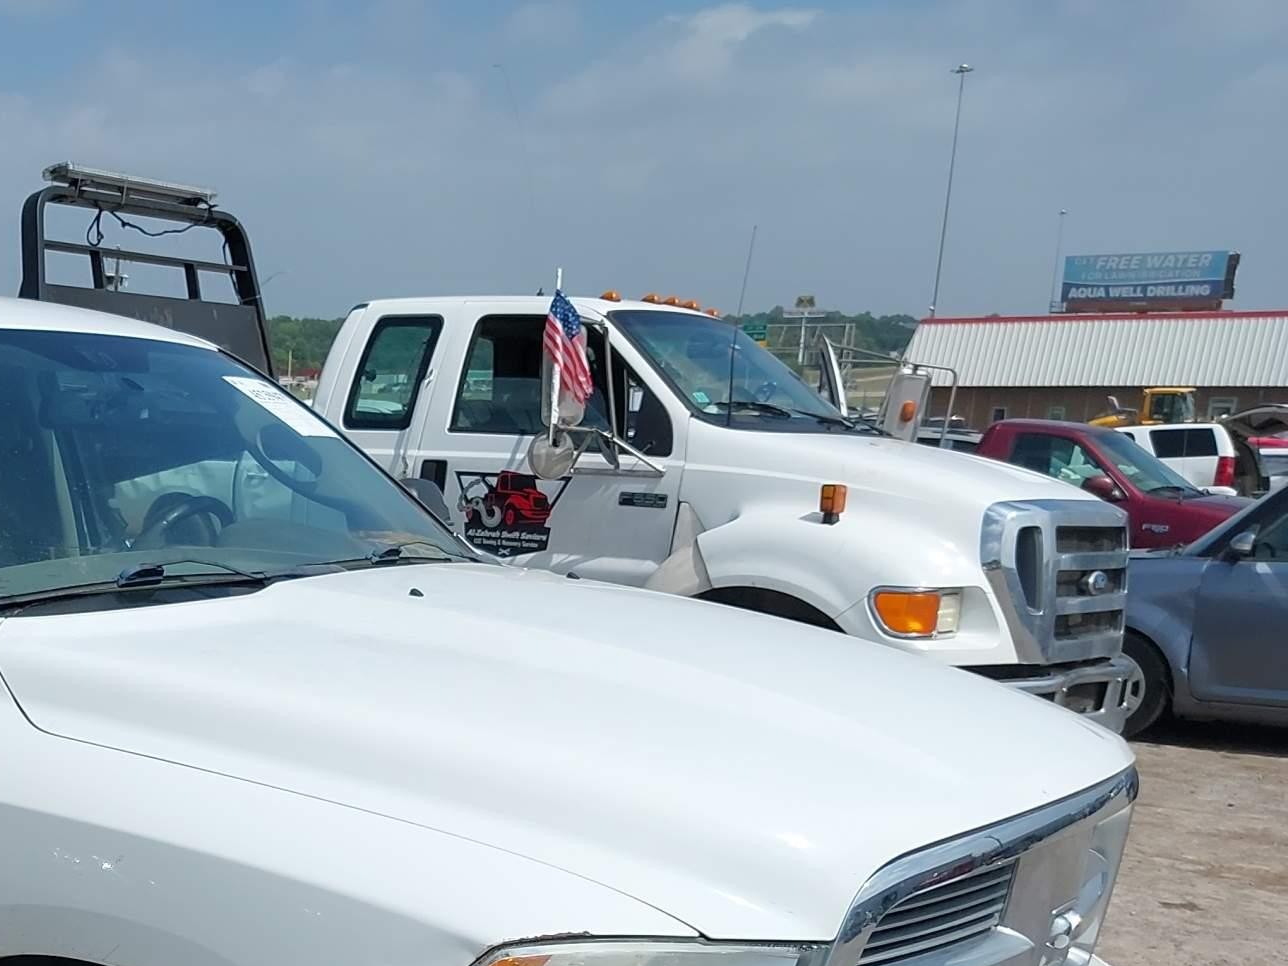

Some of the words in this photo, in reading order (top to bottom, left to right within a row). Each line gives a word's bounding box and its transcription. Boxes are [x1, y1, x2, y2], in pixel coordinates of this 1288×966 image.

[1095, 254, 1143, 270] FREE
[1146, 253, 1212, 269] WATER
[1068, 286, 1106, 299] AQUA
[1108, 285, 1143, 298] WELL
[1146, 284, 1212, 297] DRILLING
